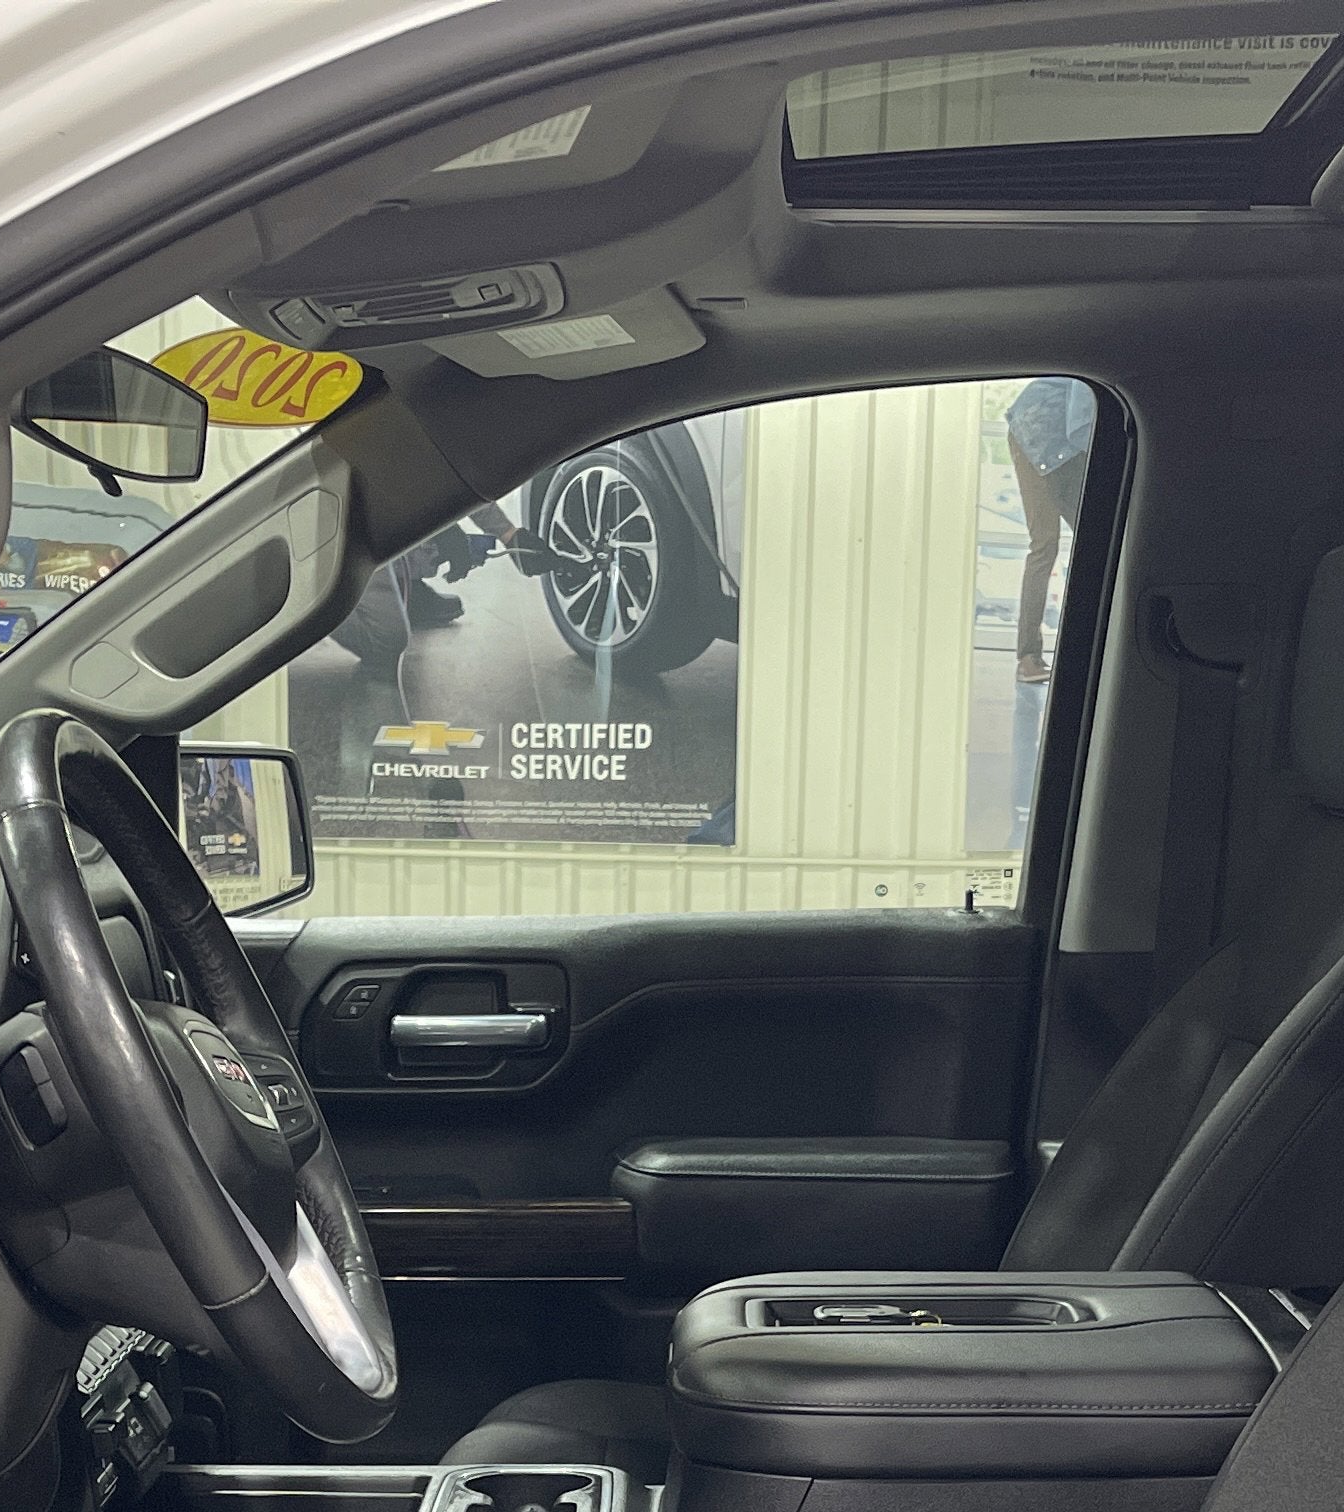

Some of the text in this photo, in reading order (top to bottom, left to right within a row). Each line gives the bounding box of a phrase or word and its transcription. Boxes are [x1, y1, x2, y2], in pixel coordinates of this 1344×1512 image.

[1238, 36, 1274, 49] visit
[1280, 37, 1294, 49] is
[510, 722, 653, 750] CERTIFIED
[372, 762, 490, 779] CHEVROLET
[510, 754, 627, 781] SERVICE
